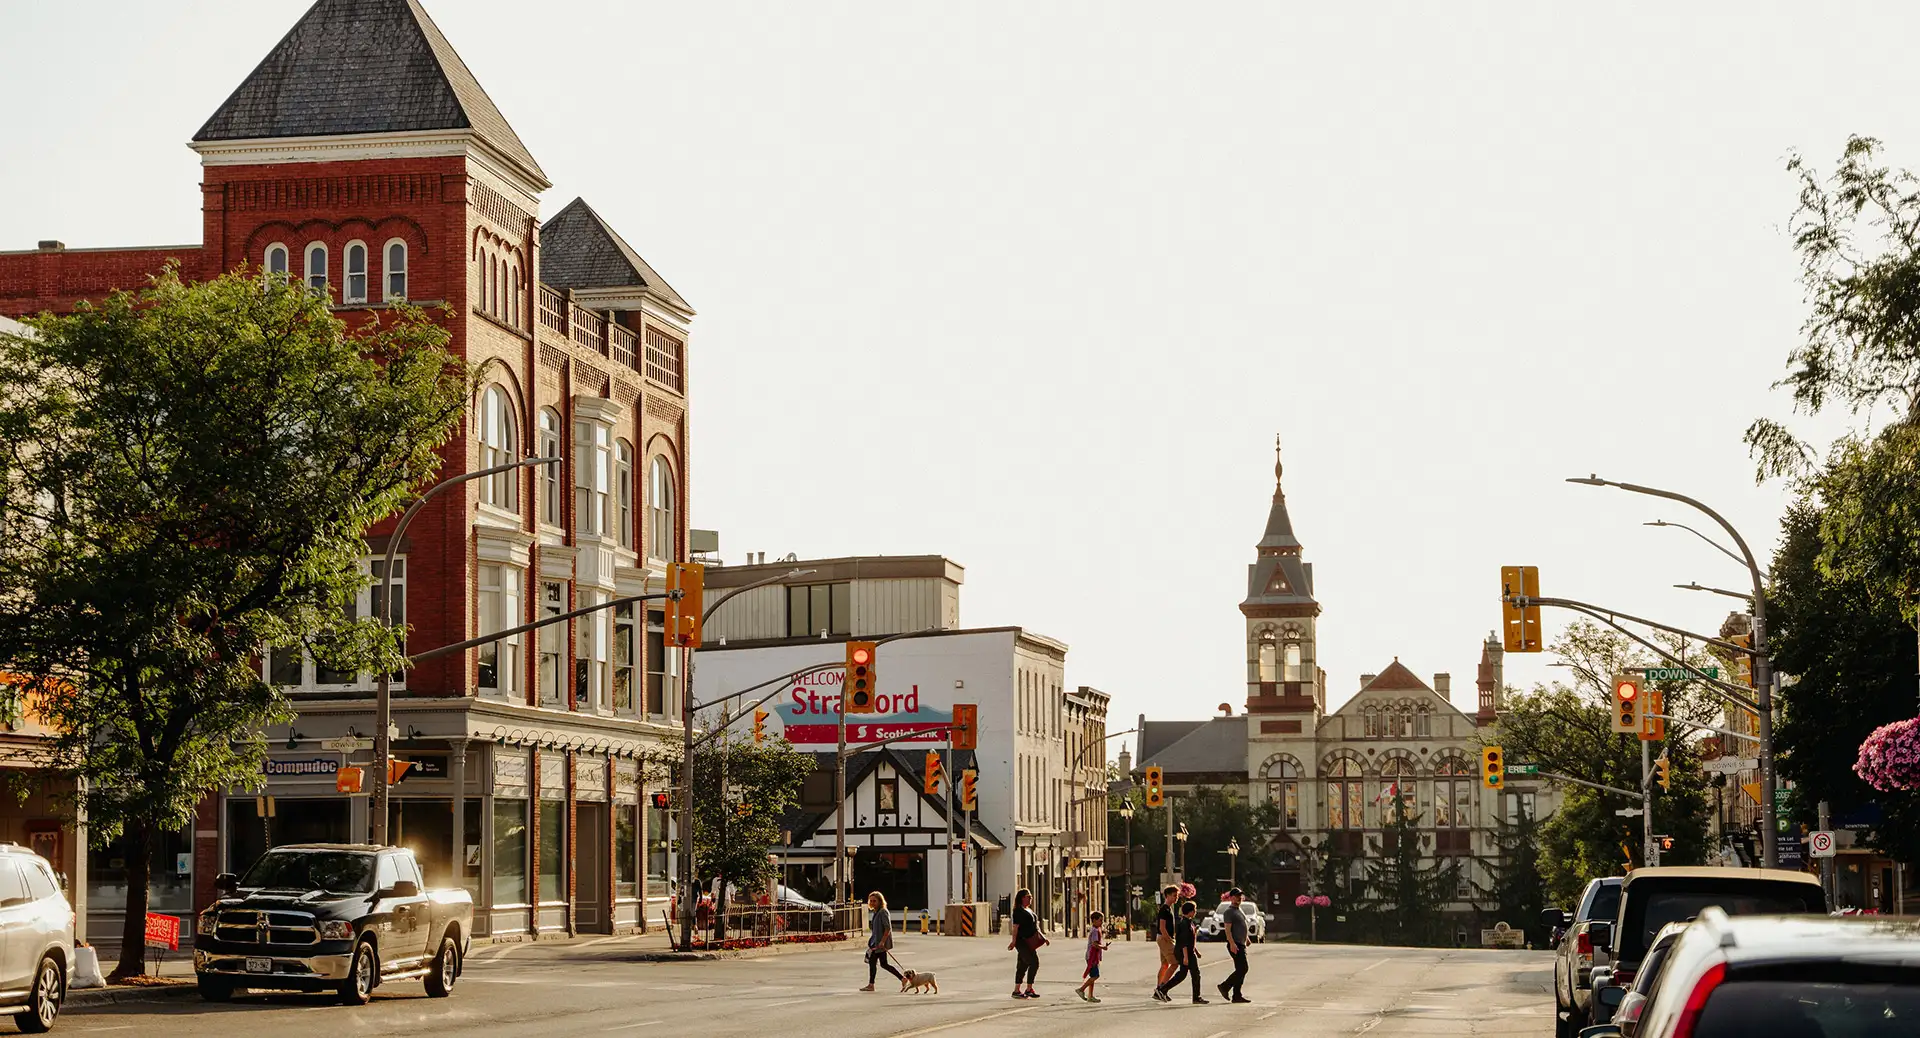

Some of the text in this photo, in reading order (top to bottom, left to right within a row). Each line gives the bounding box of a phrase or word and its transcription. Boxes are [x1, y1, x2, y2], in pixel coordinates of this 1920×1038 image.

[792, 671, 846, 686] WELCOM
[791, 685, 919, 715] Straord
[266, 760, 337, 775] Compudoc
[1508, 765, 1527, 774] ERIE
